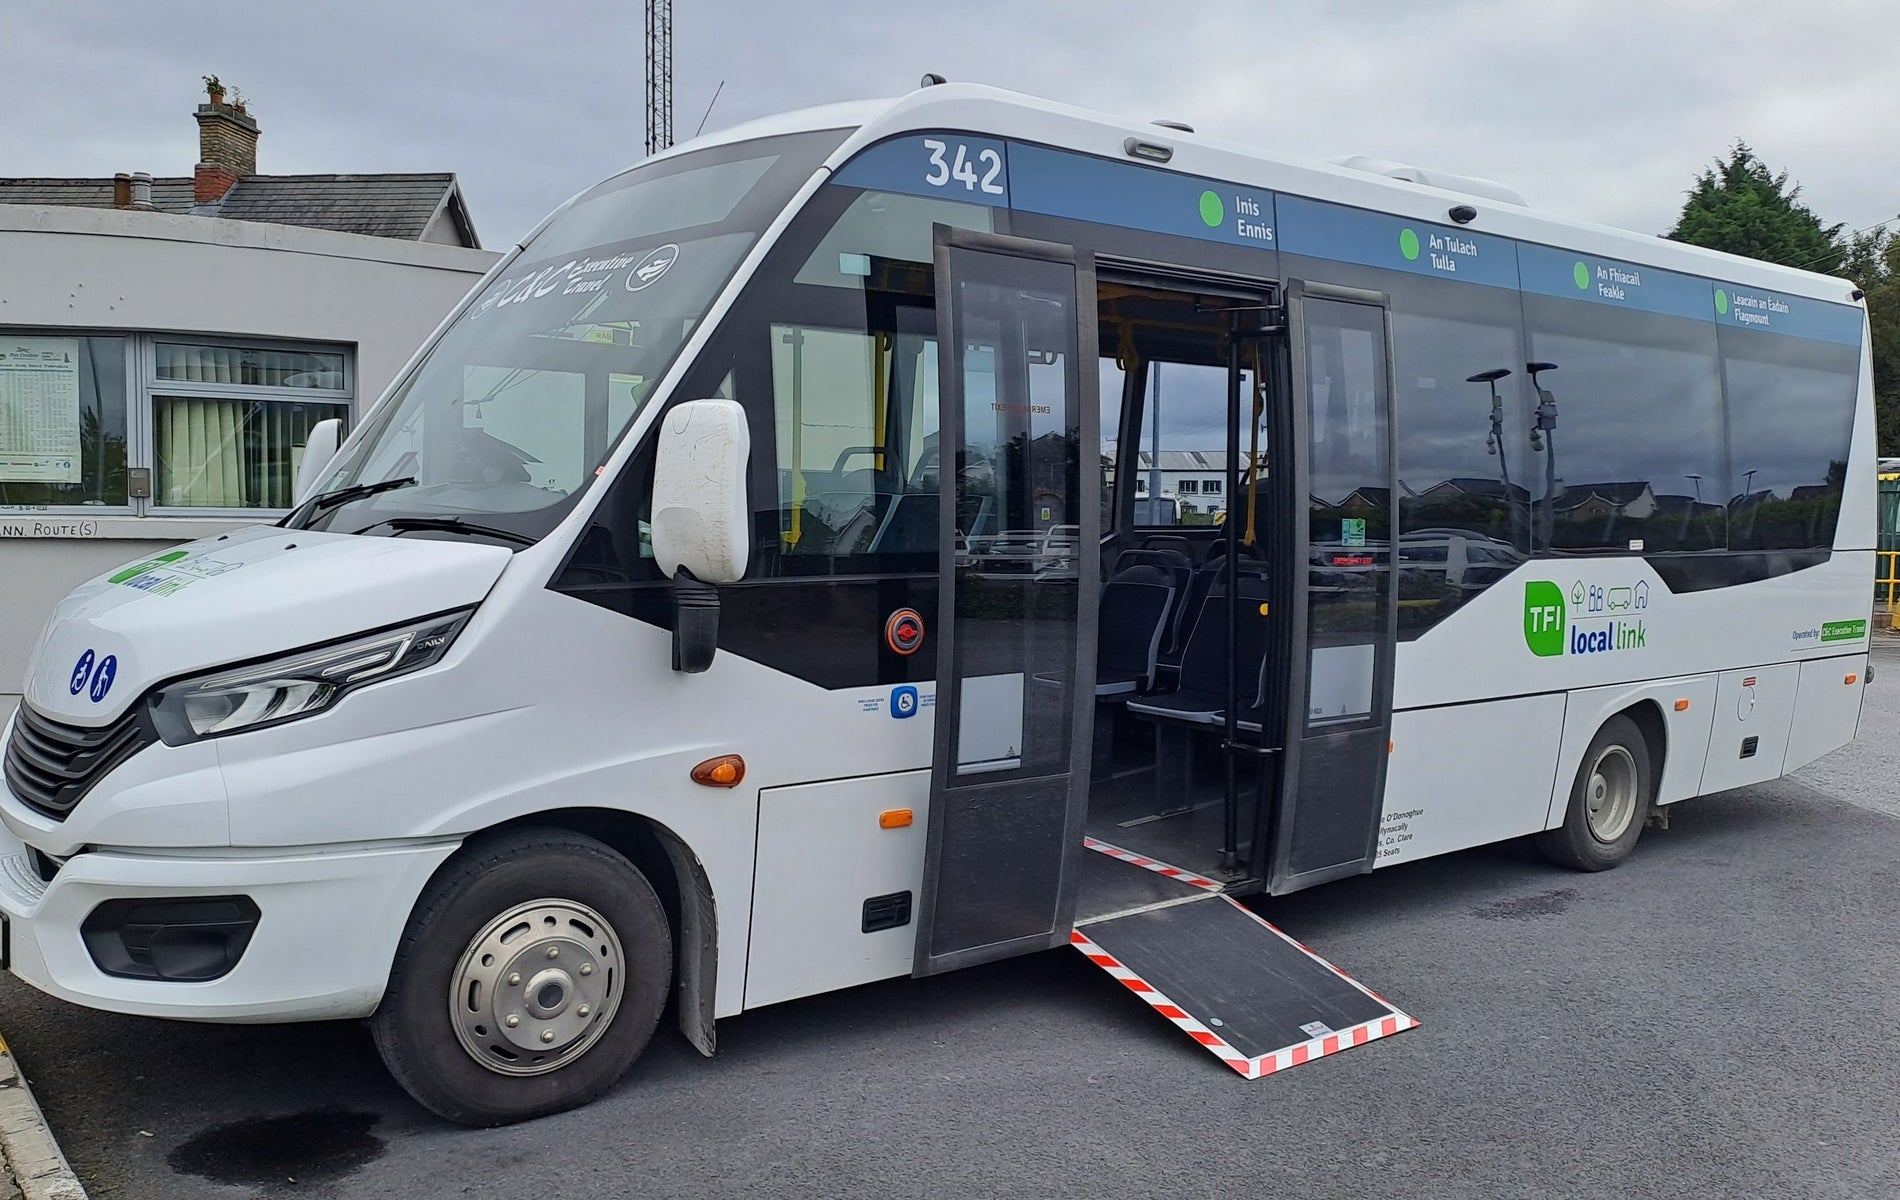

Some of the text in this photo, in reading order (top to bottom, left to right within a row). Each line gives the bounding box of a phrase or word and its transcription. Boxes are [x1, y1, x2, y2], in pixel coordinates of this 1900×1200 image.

[924, 139, 1004, 195] 342
[1235, 195, 1260, 217] Inis
[1237, 218, 1273, 241] Ennis
[1429, 233, 1478, 257] An Tulach
[566, 253, 635, 280] Executive
[1430, 253, 1456, 273] Tulla
[562, 273, 614, 297] Travel
[1596, 265, 1641, 286] An Fhiacail
[1598, 283, 1625, 300] Feakle
[1732, 291, 1759, 309] Leacain
[1759, 300, 1768, 310] an
[1734, 308, 1770, 326] Flagmount
[0, 521, 98, 536] NN. ROUTE(S)
[1529, 605, 1561, 633] TFI
[417, 636, 446, 650] DAILY
[1571, 619, 1647, 655] local link
[1397, 834, 1414, 843] Clare
